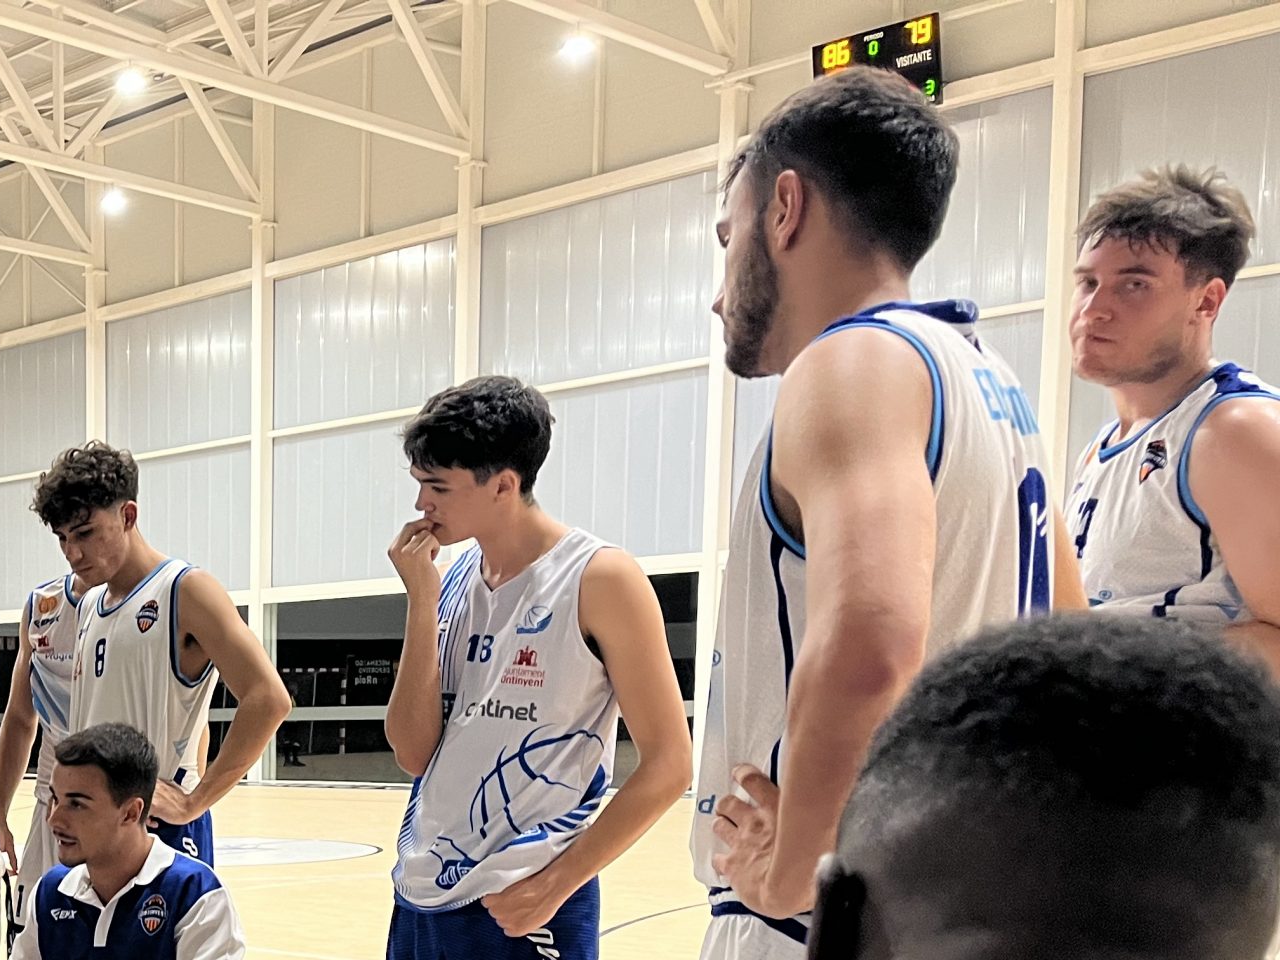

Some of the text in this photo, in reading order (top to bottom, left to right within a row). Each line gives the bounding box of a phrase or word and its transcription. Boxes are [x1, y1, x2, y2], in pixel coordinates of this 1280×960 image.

[822, 39, 851, 69] 86
[896, 49, 933, 68] VISITANTE
[94, 637, 107, 678] 8
[466, 633, 495, 663] 18
